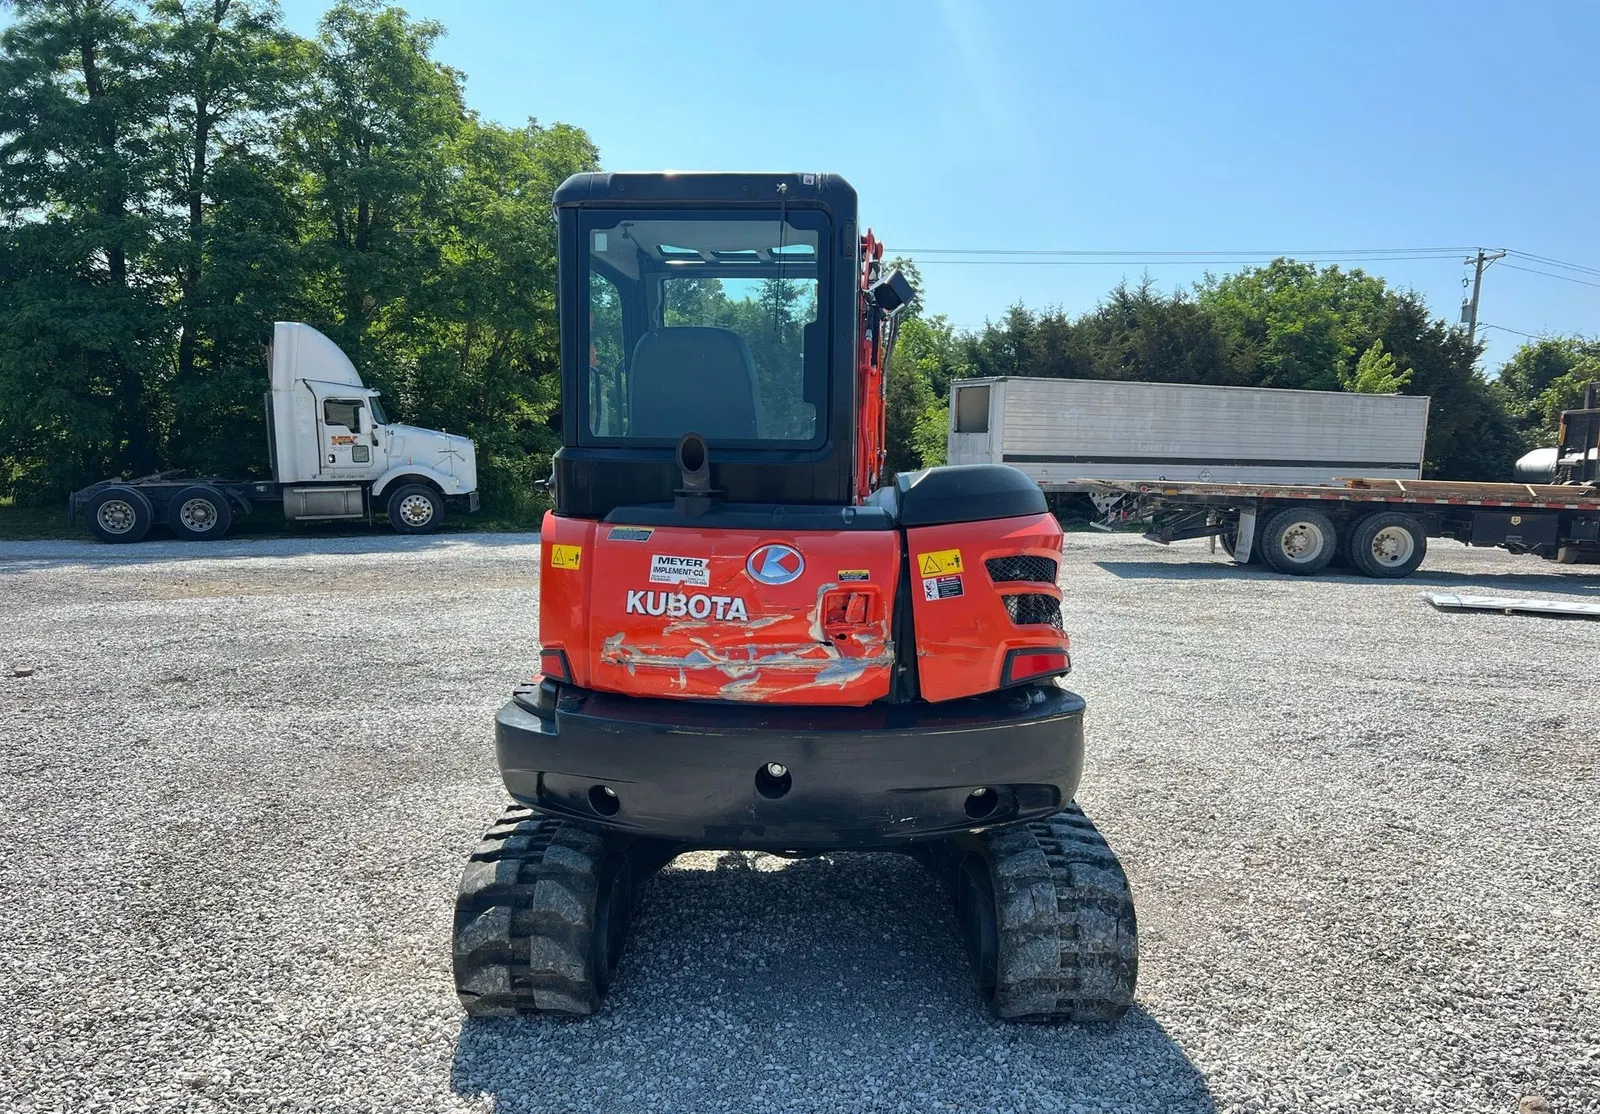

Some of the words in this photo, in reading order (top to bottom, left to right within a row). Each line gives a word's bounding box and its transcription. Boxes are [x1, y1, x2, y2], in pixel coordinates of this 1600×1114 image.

[658, 556, 703, 567] MEYER
[653, 566, 693, 575] IMPLEMENT
[626, 589, 749, 622] KUBOTA
